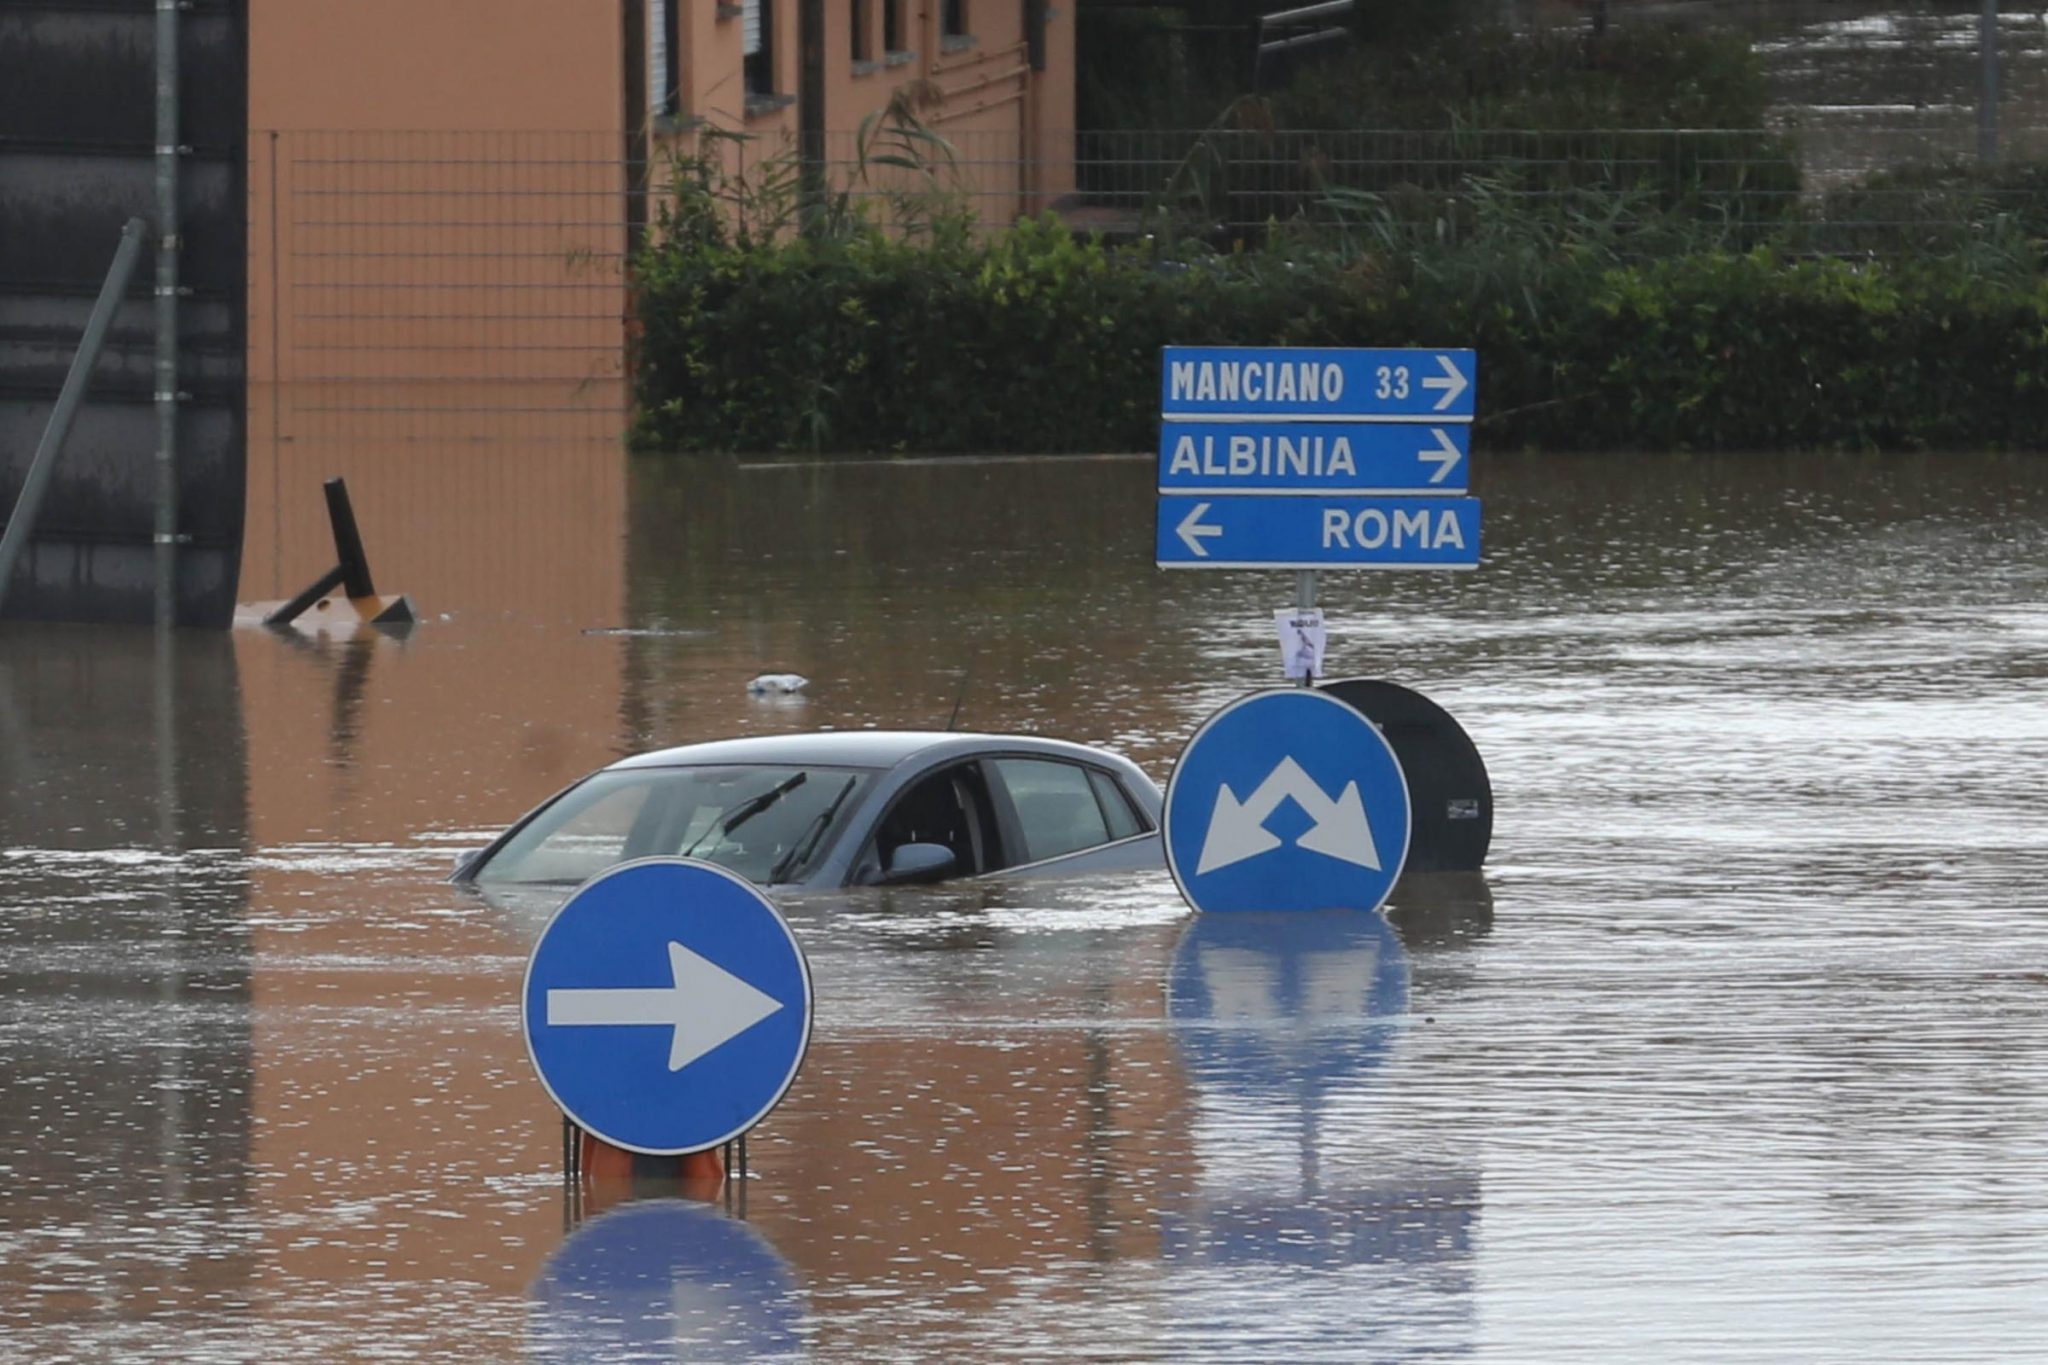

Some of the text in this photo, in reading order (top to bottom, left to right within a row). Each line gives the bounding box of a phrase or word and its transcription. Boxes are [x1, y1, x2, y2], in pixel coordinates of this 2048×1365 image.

[1171, 361, 1409, 401] MANCIANO 33
[1169, 435, 1357, 476] ALBINIA
[1322, 508, 1465, 549] ROMA
